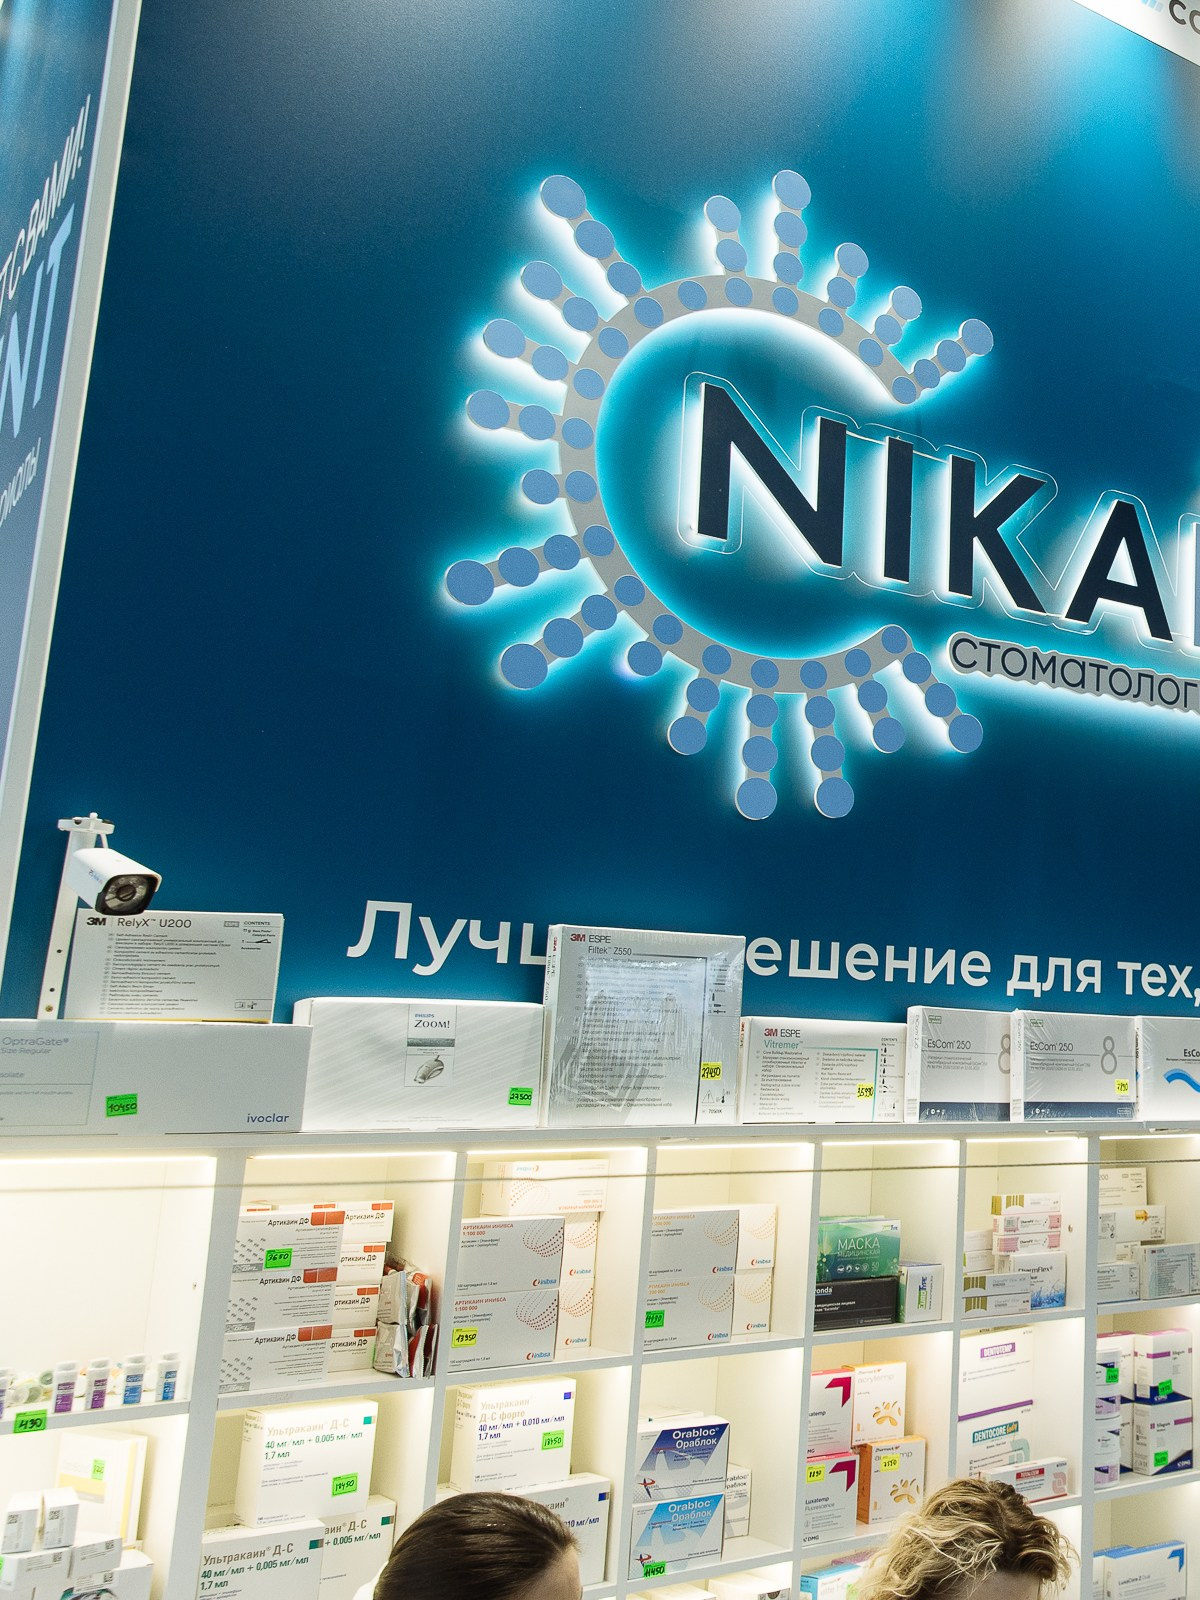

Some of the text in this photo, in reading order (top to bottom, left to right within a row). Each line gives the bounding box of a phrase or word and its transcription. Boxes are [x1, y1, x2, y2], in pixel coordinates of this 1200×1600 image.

[22, 93, 91, 276] ВАМИ!
[0, 203, 75, 438] NT
[86, 917, 193, 930] 3M RelyX U200
[570, 933, 612, 944] 3M ESPE
[346, 900, 547, 976] Луч
[745, 937, 992, 987] ешение
[1007, 954, 1101, 998] для
[588, 945, 632, 956] Filtek Z550
[764, 1028, 801, 1038] 3M ESPE
[2, 1036, 64, 1048] OptraGate
[763, 1039, 799, 1049] Vitremer
[927, 1038, 971, 1050] EsCom 250
[1030, 1041, 1073, 1052] EsCom 250
[246, 1112, 290, 1124] ivoclar
[268, 1216, 310, 1227] Артикаин ДФ
[345, 1213, 373, 1221] Артикаин
[462, 1223, 492, 1231] АРТИКАИН
[837, 1237, 880, 1251] МАСКА
[340, 1253, 377, 1264] ртикаин ДФ
[837, 1249, 881, 1258] МЕДИЦИНСКАЯ
[259, 1274, 302, 1286] Артикаин ДФ
[334, 1296, 371, 1306] ртикаин ДФ
[254, 1333, 297, 1345] Артикаин ДФ
[330, 1338, 368, 1349] ртикаин ДФ
[858, 1373, 895, 1385] acrytemp
[481, 1398, 530, 1411] Ультракаин
[479, 1409, 525, 1424] Д-С форте
[267, 1423, 325, 1438] Ультракаин
[330, 1417, 350, 1432] Д-С
[478, 1423, 487, 1433] 40
[672, 1427, 716, 1440] Orabloc
[973, 1426, 1007, 1442] DENTOCORE
[265, 1440, 275, 1450] 40
[675, 1437, 717, 1449] Ораблок
[726, 1474, 748, 1482] rabloc
[726, 1482, 746, 1490] раблок
[668, 1499, 711, 1513] Orabloc
[805, 1496, 830, 1505] Luxatemp
[671, 1508, 712, 1523] Ораблок
[348, 1519, 368, 1532] Д-С
[333, 1536, 353, 1547] 0,005
[354, 1531, 381, 1543] мг/мл
[203, 1542, 294, 1567] Ультракаин Д-С
[201, 1569, 212, 1580] 40
[213, 1566, 245, 1578] мг/мл
[256, 1559, 278, 1572] 0,005
[279, 1555, 309, 1569] мг/мл
[200, 1579, 229, 1591] 1,7 мл
